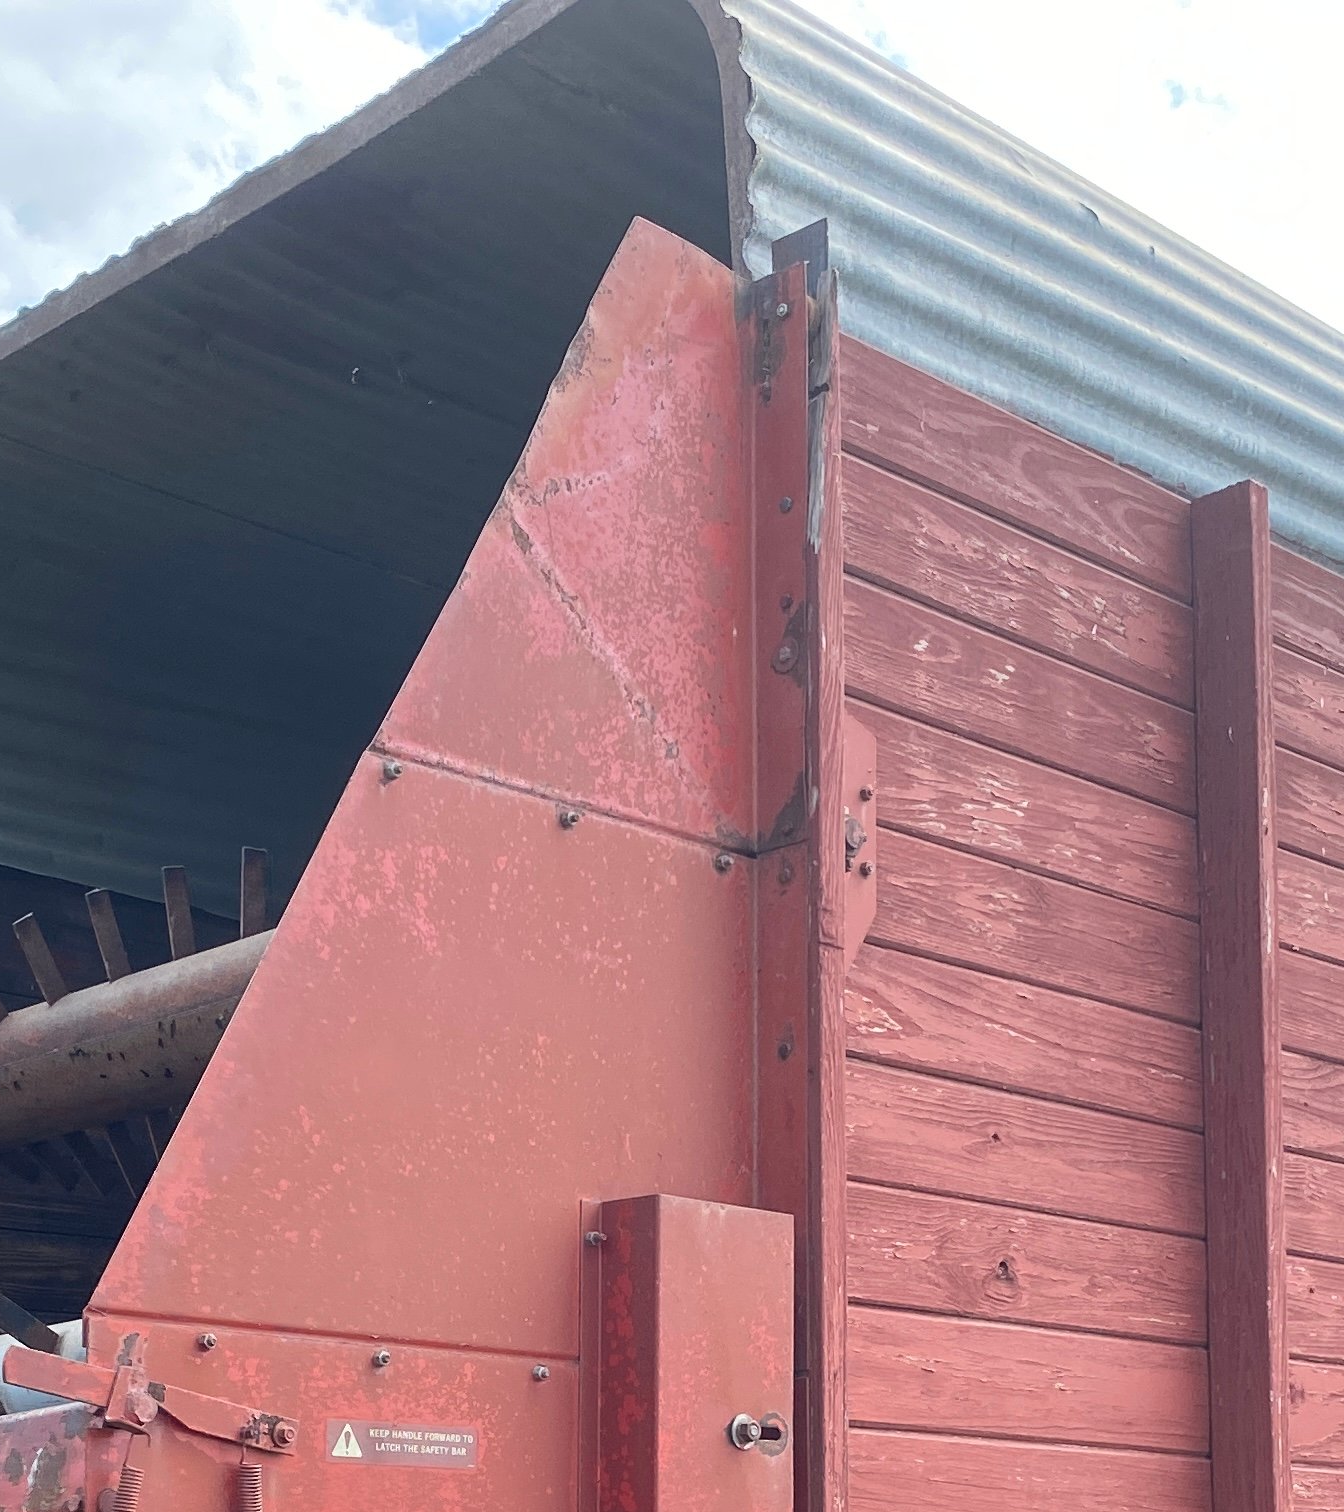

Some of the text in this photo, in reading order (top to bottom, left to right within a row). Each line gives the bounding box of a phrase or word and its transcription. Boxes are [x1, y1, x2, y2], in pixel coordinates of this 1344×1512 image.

[369, 1428, 474, 1444] KEEP HANDLE FORWARD TO
[375, 1442, 467, 1456] LATCH THE SAFETY BAR
